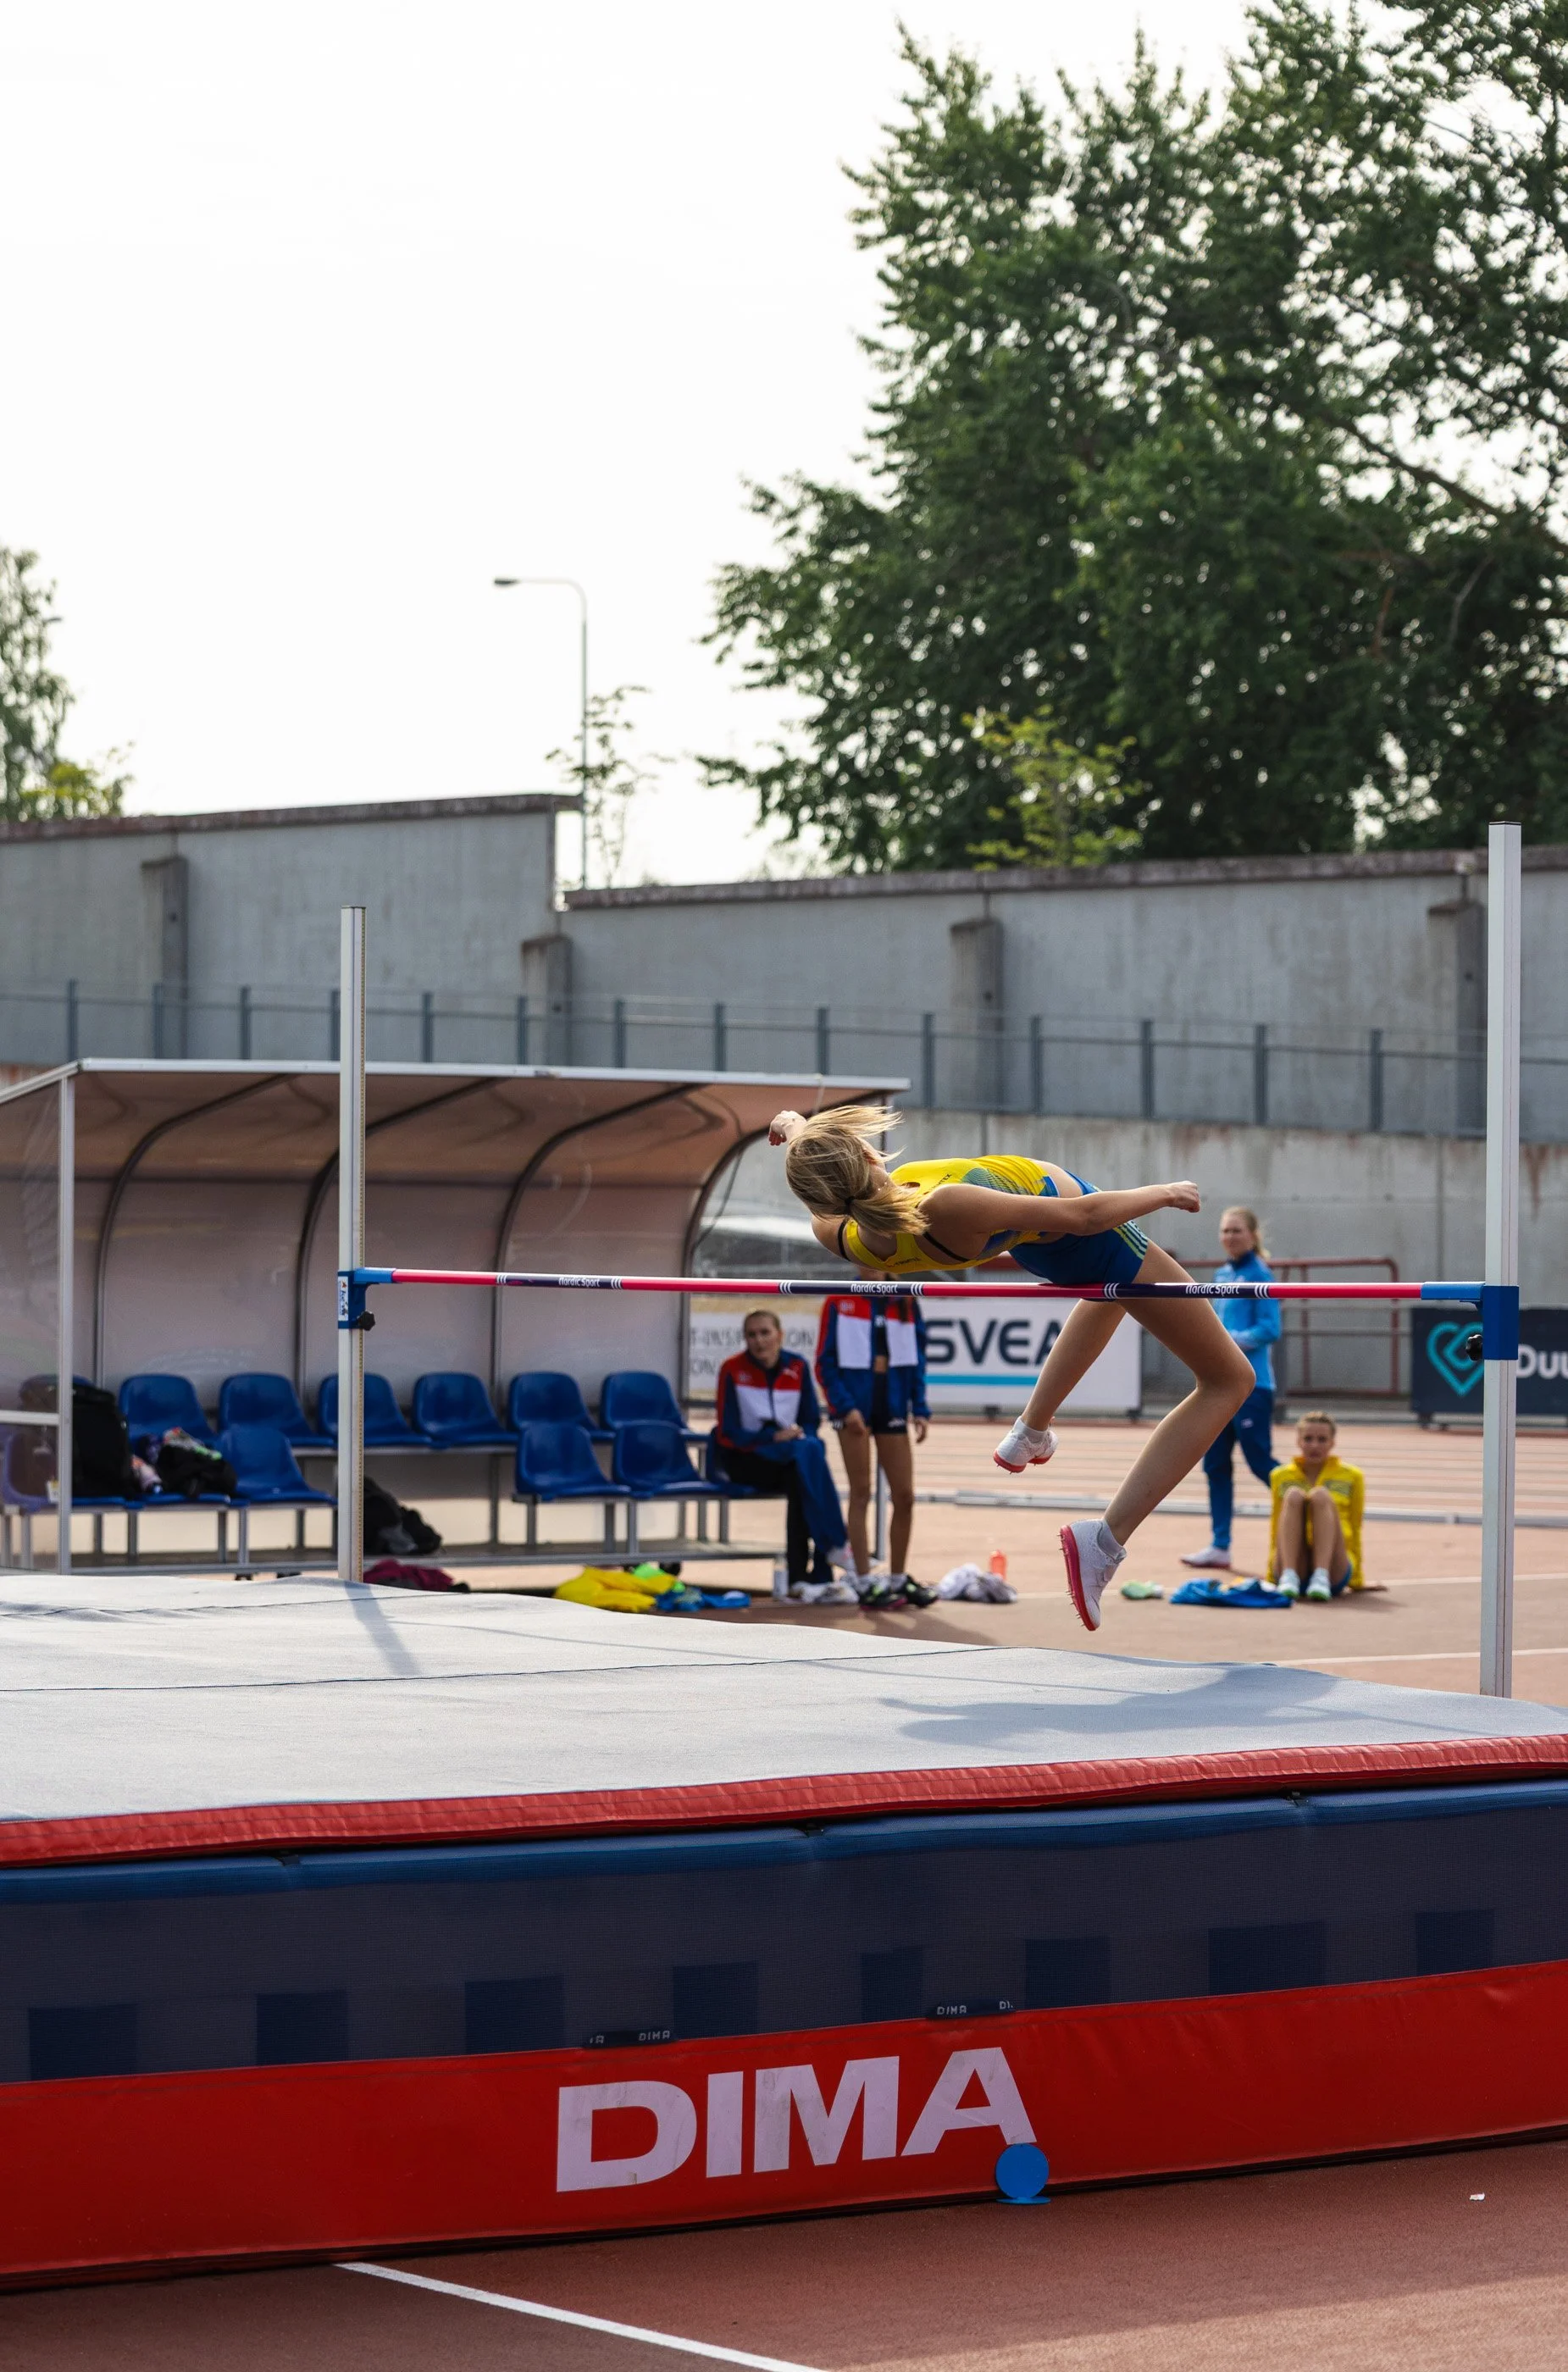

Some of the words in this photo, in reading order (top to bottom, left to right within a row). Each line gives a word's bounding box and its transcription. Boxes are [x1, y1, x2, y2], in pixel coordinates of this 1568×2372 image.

[581, 1277, 600, 1288] Sport
[876, 1283, 898, 1295] Sport
[1215, 1284, 1240, 1297] Sport
[937, 2004, 967, 2015] DIMA
[638, 2030, 670, 2042] DIMA
[557, 2047, 1037, 2192] DIMA
